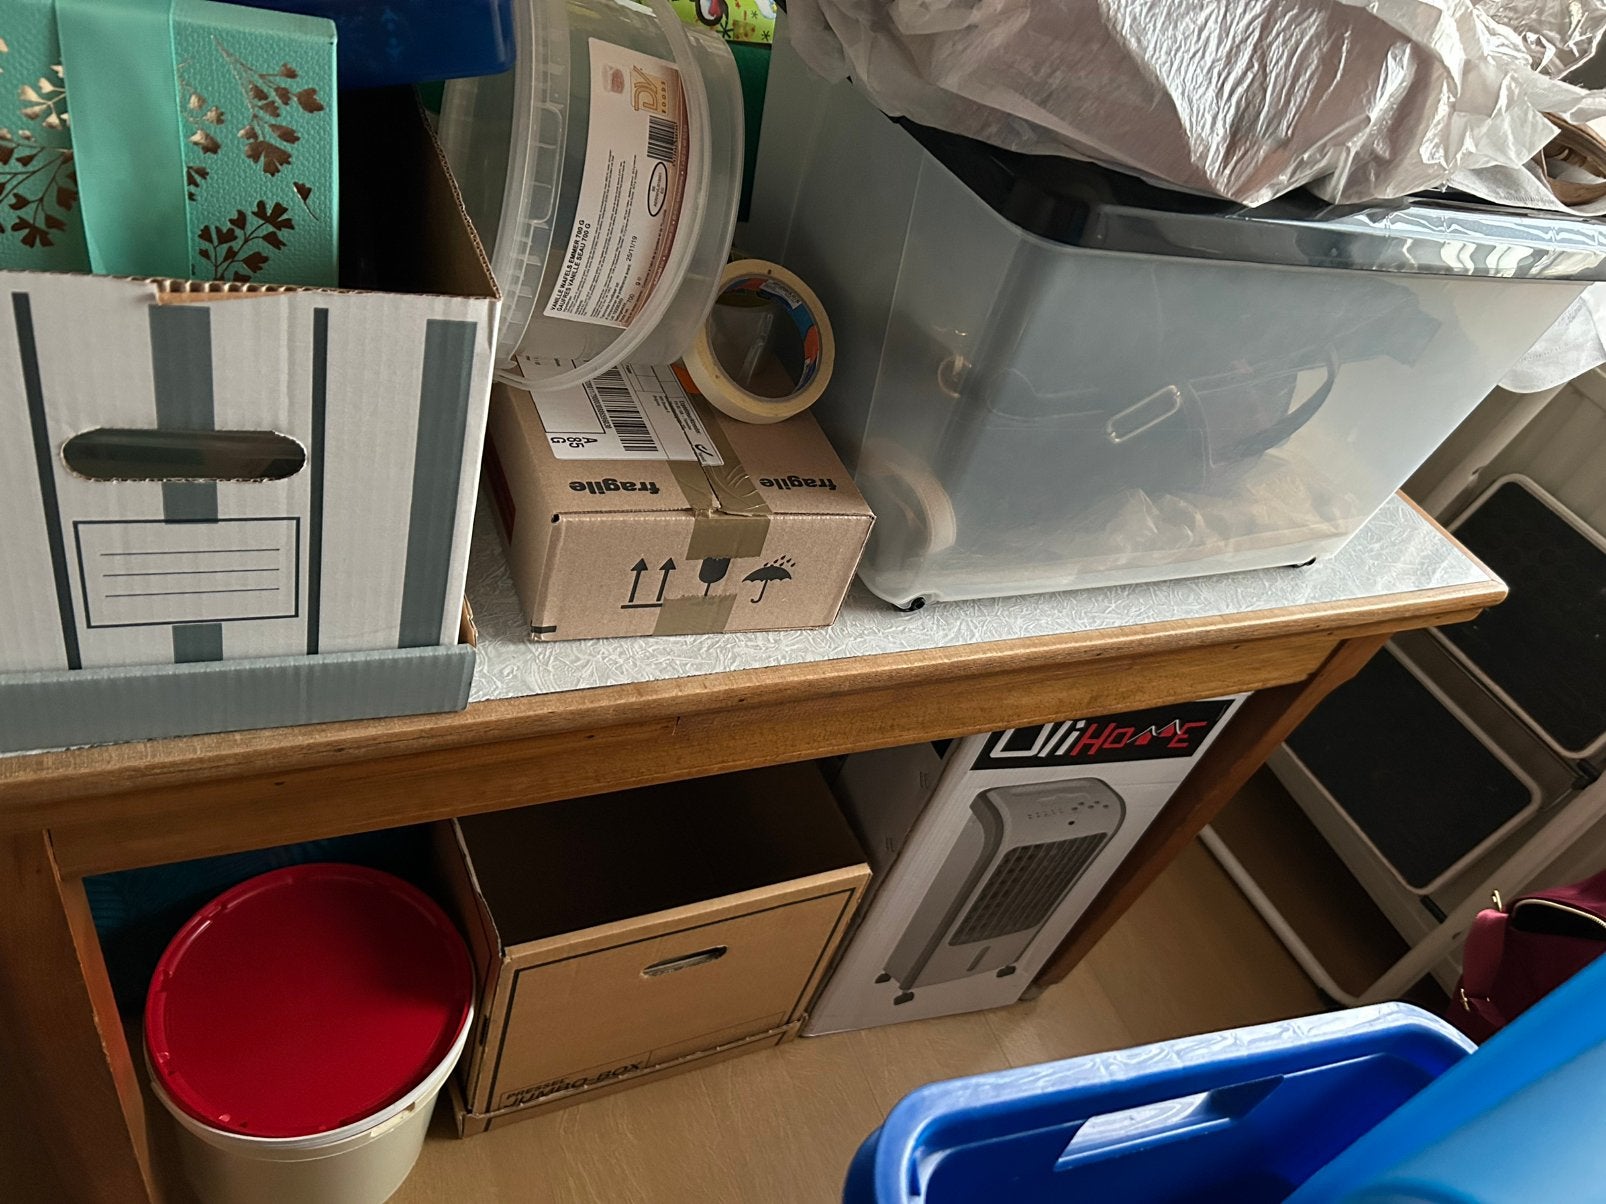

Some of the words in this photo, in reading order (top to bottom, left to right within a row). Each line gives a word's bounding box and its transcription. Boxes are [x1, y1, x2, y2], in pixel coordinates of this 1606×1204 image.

[626, 235, 638, 262] 25/11/19
[550, 289, 564, 311] VANILLE
[559, 264, 572, 288] WAFELS
[568, 240, 579, 264] EMMER
[557, 287, 572, 311] GAUFRES
[567, 261, 580, 286] VANILLE
[577, 242, 586, 261] SEAU
[627, 293, 635, 303] 700
[567, 437, 584, 448] 85
[569, 478, 660, 494] fragile
[759, 475, 837, 491] fragile
[506, 1078, 566, 1100] PRESSEL
